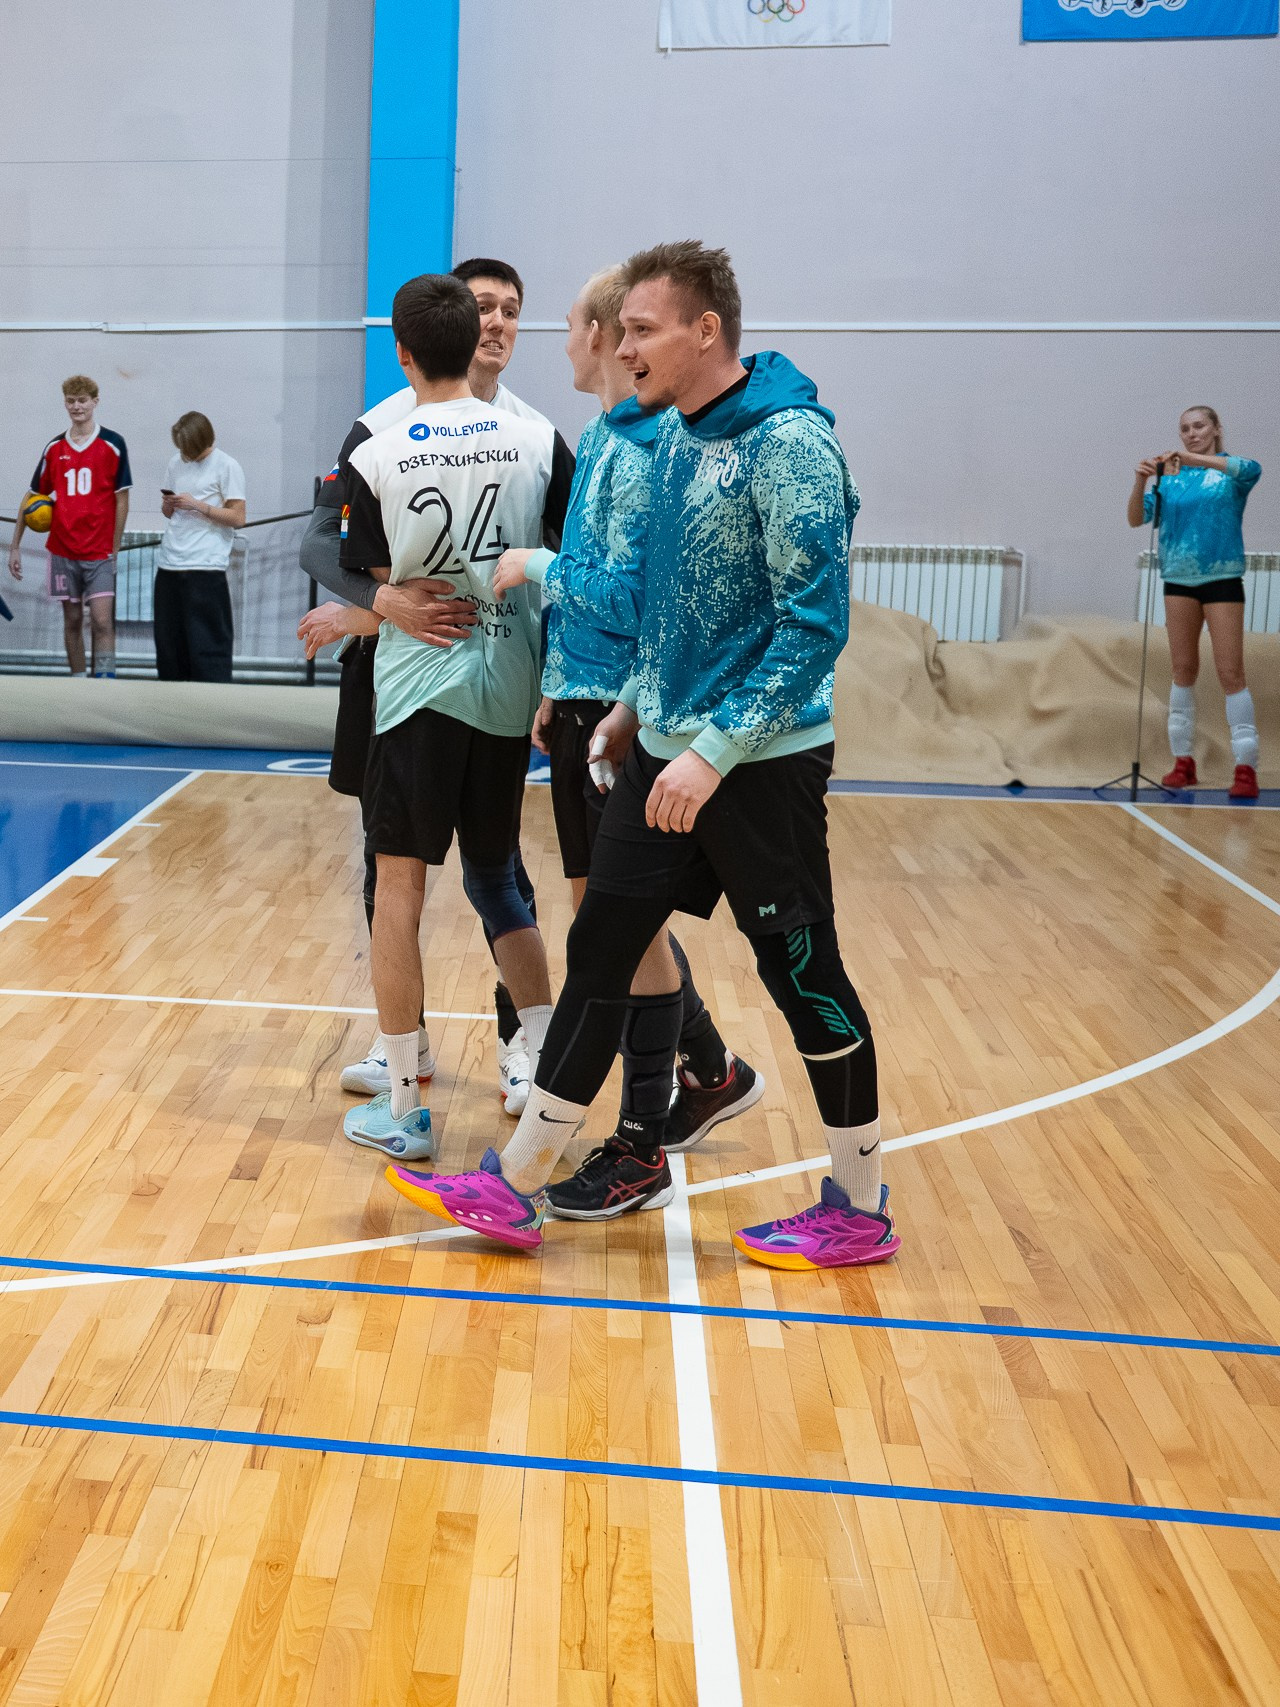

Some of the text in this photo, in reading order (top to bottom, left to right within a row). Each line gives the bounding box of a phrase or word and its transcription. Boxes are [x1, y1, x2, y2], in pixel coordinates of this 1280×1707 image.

[432, 420, 499, 437] VOLLEYDZR
[397, 447, 519, 474] ДЗЕРЖИНСКИЙ
[64, 467, 92, 496] 10
[407, 483, 510, 578] 24
